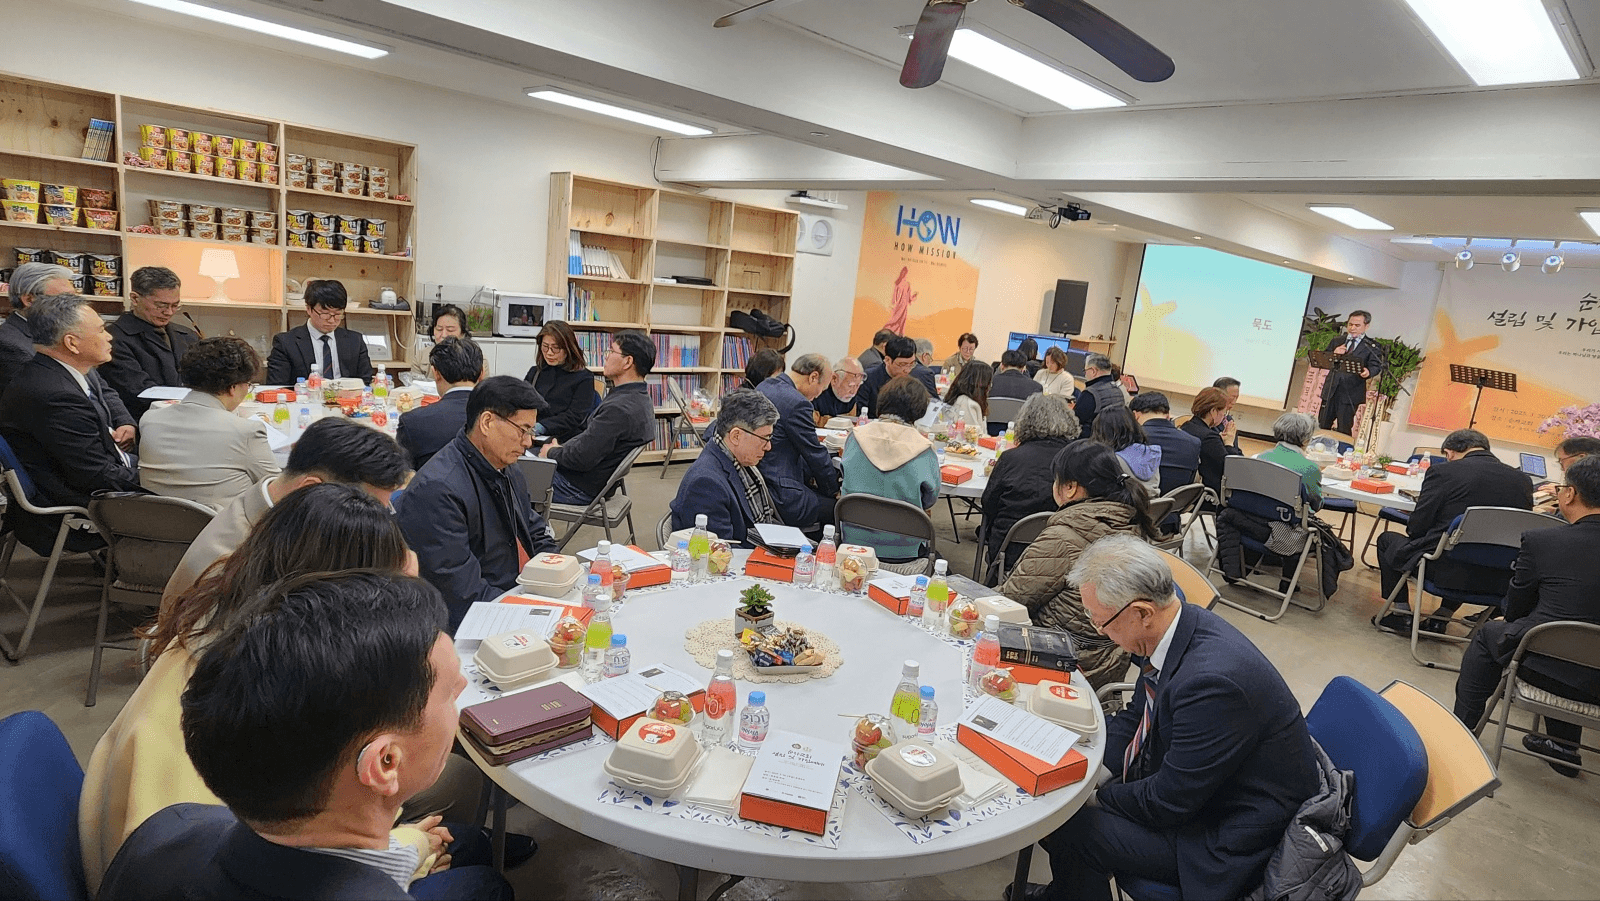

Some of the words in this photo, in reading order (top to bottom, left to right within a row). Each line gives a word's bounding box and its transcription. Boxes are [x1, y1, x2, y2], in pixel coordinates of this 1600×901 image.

[896, 205, 960, 246] HOW
[894, 241, 913, 252] HOW
[919, 246, 956, 259] MISSION
[1579, 292, 1600, 312] 순
[1252, 317, 1273, 331] 묵도
[1487, 309, 1527, 327] 설립
[1535, 312, 1557, 331] 및
